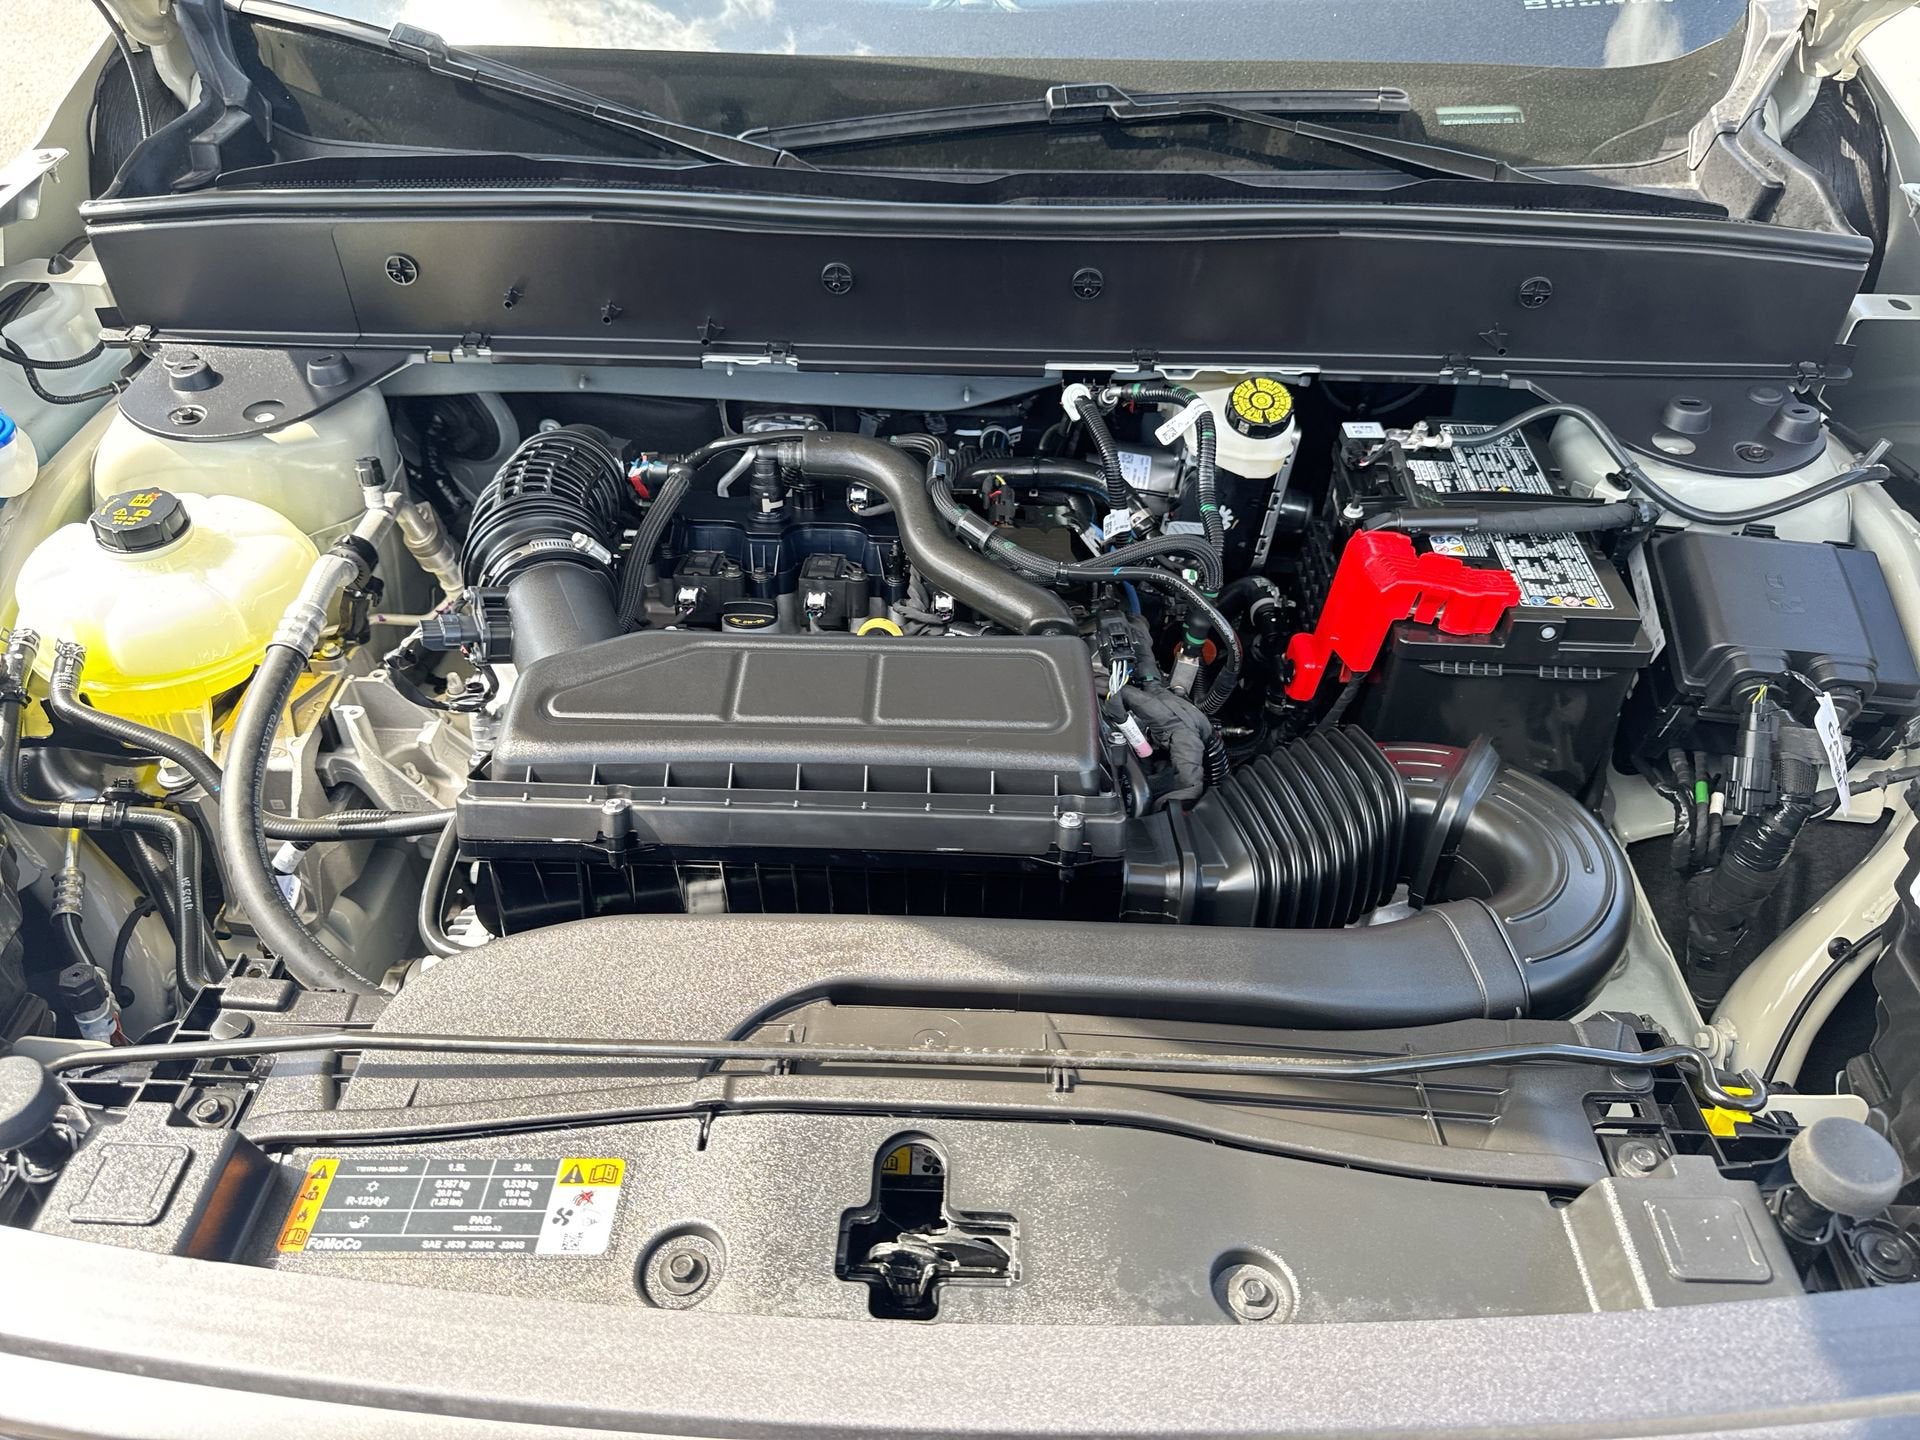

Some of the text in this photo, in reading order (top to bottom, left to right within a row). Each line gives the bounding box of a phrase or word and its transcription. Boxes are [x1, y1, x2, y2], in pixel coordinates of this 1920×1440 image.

[260, 713, 277, 756] GALAXY
[345, 1196, 390, 1207] R-1234yf
[469, 1215, 492, 1225] PAG
[305, 1237, 362, 1250] FoMoCo
[421, 1240, 442, 1249] SAE
